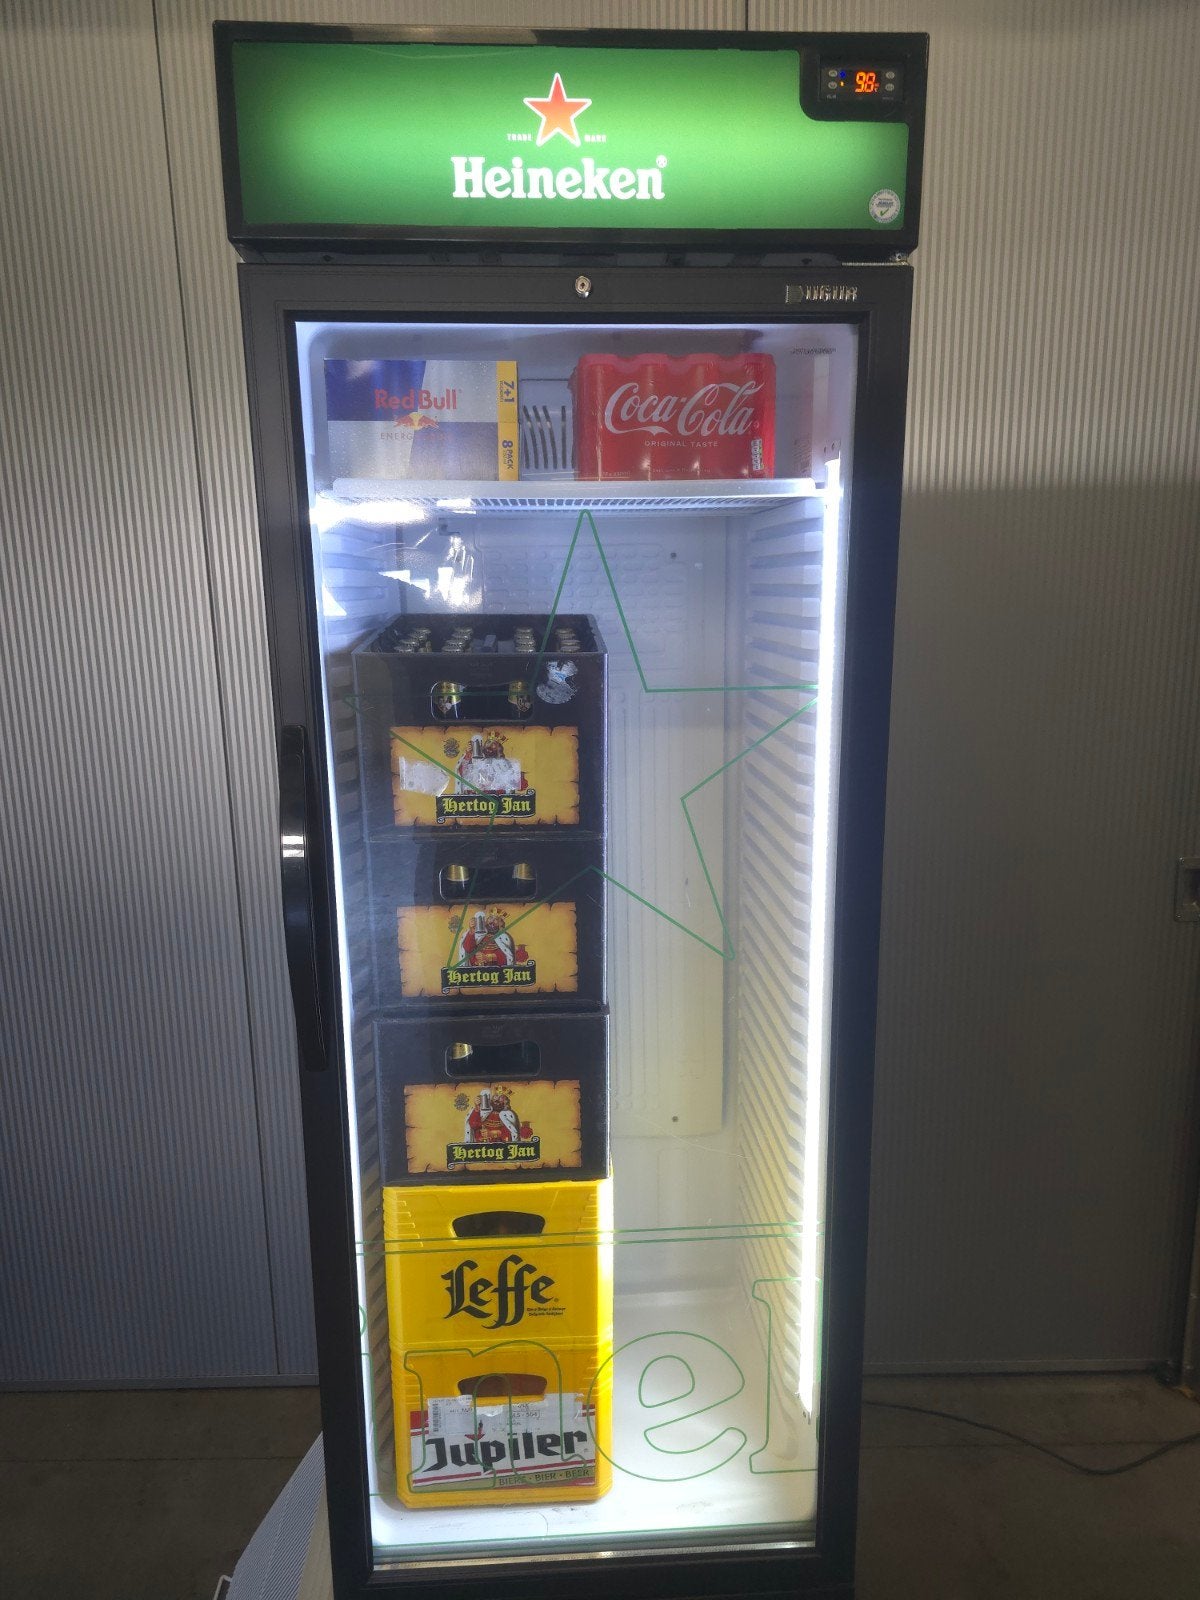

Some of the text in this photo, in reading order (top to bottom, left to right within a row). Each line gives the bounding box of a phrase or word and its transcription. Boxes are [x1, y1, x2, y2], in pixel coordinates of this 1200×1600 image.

[450, 156, 666, 200] Heineken
[374, 388, 457, 411] Red Bull
[604, 380, 765, 437] Coca-Cola
[380, 432, 419, 441] ENERG
[644, 439, 720, 449] ORIGINAL TASTE
[442, 796, 531, 815] Hertog Jan
[447, 968, 531, 986] Hertog Jan
[452, 1144, 536, 1161] Hertog Jan
[440, 1254, 556, 1330] Leffe
[423, 1430, 588, 1472] Jupiler
[534, 1471, 557, 1482] BIER
[565, 1468, 589, 1479] BEER
